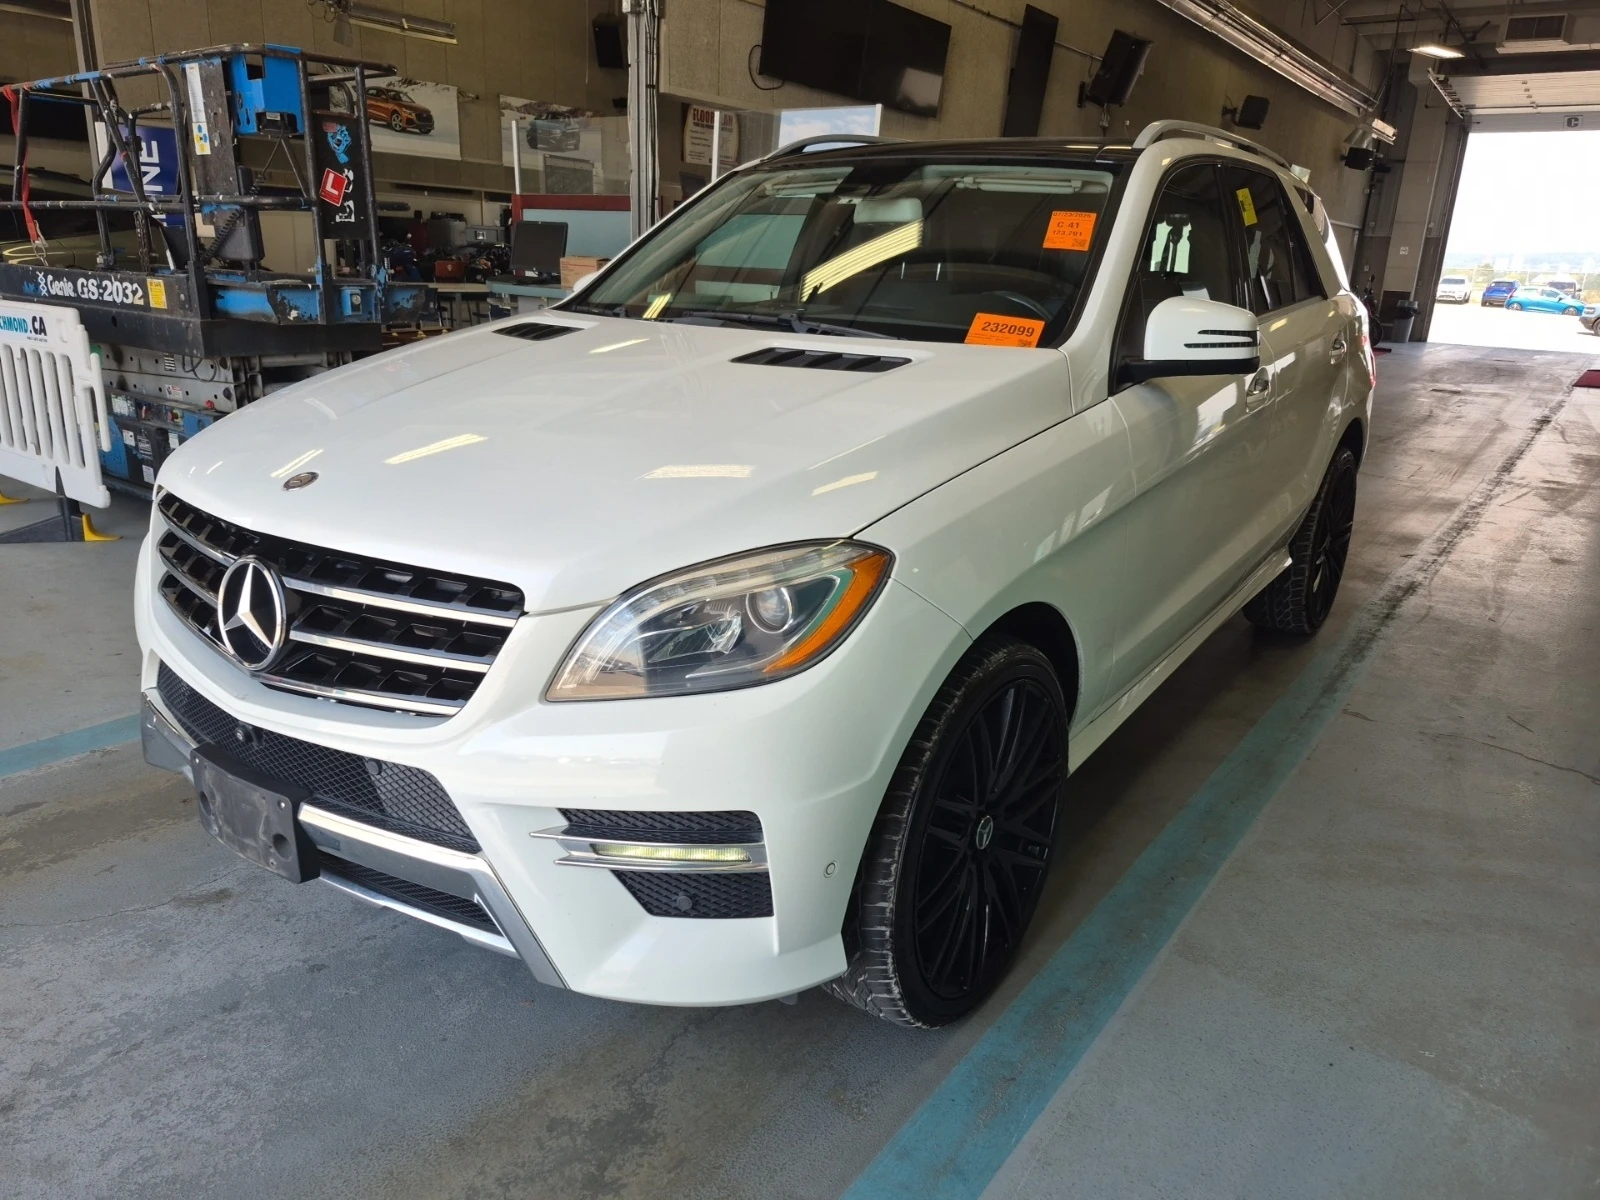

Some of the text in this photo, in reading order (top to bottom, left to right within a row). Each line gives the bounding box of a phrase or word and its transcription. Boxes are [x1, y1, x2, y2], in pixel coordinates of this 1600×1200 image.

[693, 108, 715, 124] FLOOR
[47, 275, 75, 297] Genie
[77, 277, 144, 306] GS-2032
[981, 321, 1035, 337] 232099
